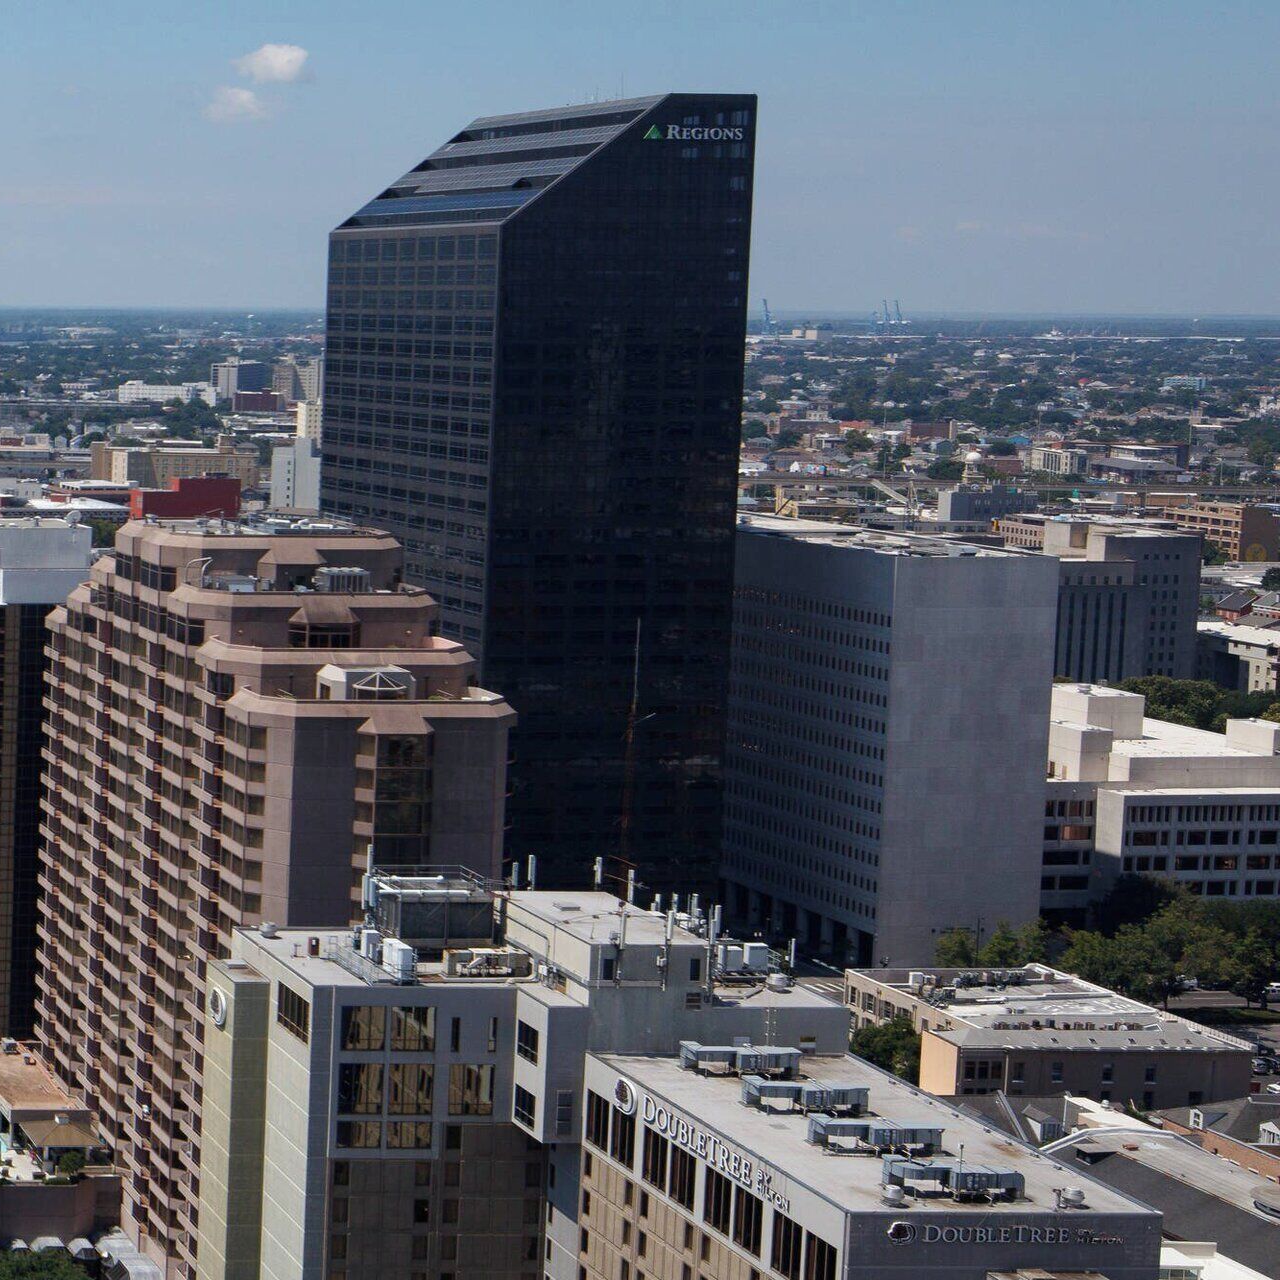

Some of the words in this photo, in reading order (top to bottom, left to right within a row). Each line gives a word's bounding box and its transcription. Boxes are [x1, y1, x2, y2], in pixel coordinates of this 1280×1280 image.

[666, 124, 743, 140] REGIONS
[757, 1169, 772, 1185] BY
[756, 1180, 790, 1212] HILTON
